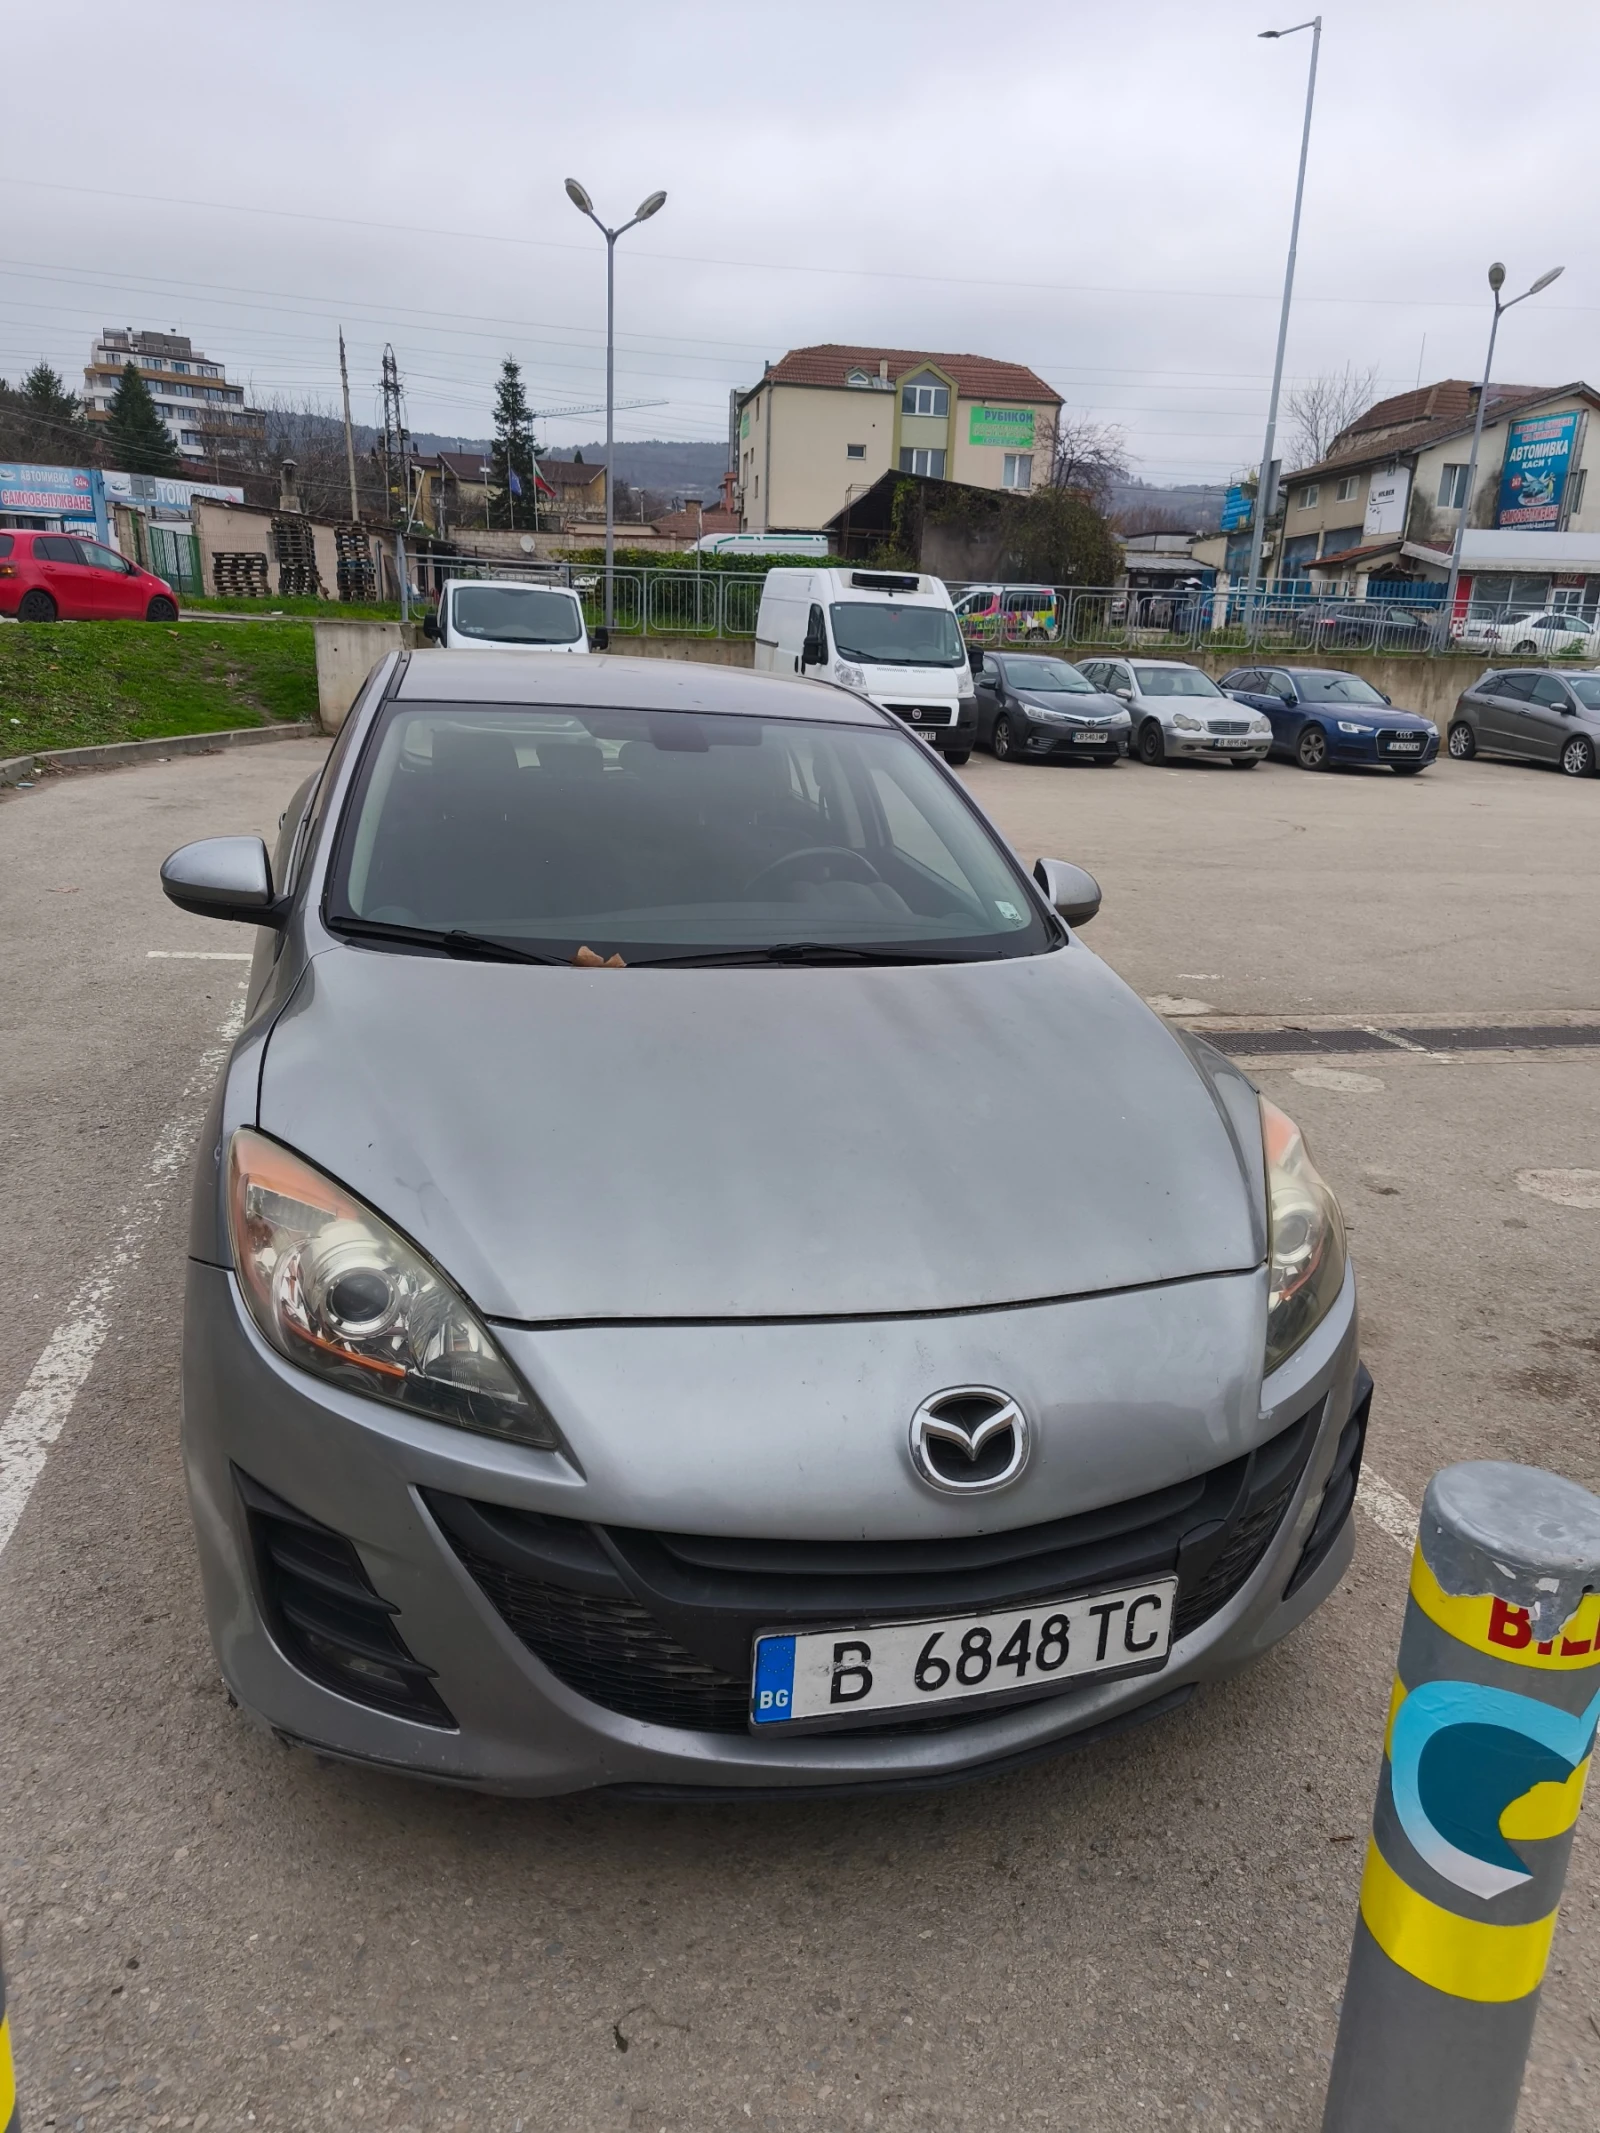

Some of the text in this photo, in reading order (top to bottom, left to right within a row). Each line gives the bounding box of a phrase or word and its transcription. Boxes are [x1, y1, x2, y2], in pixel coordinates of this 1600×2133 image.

[985, 410, 1033, 423] РУБИКОН
[1509, 440, 1568, 462] АВТОМИВКА
[1522, 458, 1552, 469] КАСИ 1
[20, 469, 70, 484] АВТОМИВКА
[2, 490, 92, 511] САМООБСЛУЖВАНЕ
[1501, 505, 1559, 525] САМООБСЛУЖВАНЕ
[830, 1594, 1162, 1704] B 6848 TC
[759, 1689, 789, 1710] BG
